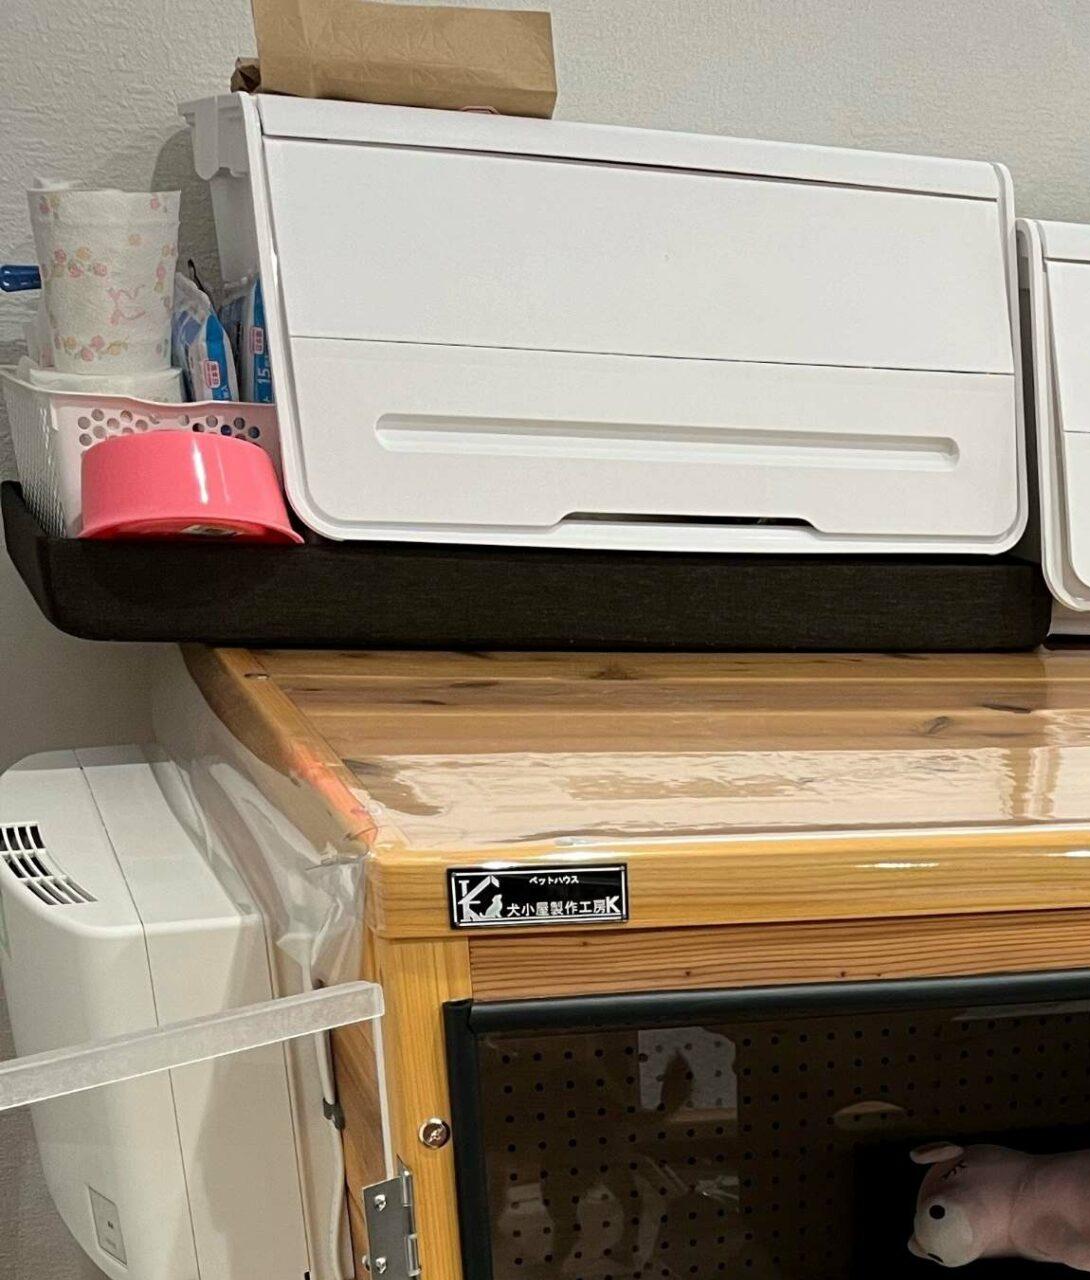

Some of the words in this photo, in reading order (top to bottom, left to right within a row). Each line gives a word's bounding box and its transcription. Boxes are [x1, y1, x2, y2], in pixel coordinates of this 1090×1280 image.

[528, 875, 580, 885] ペットハウス
[506, 895, 621, 917] 犬小屋製作工房K
